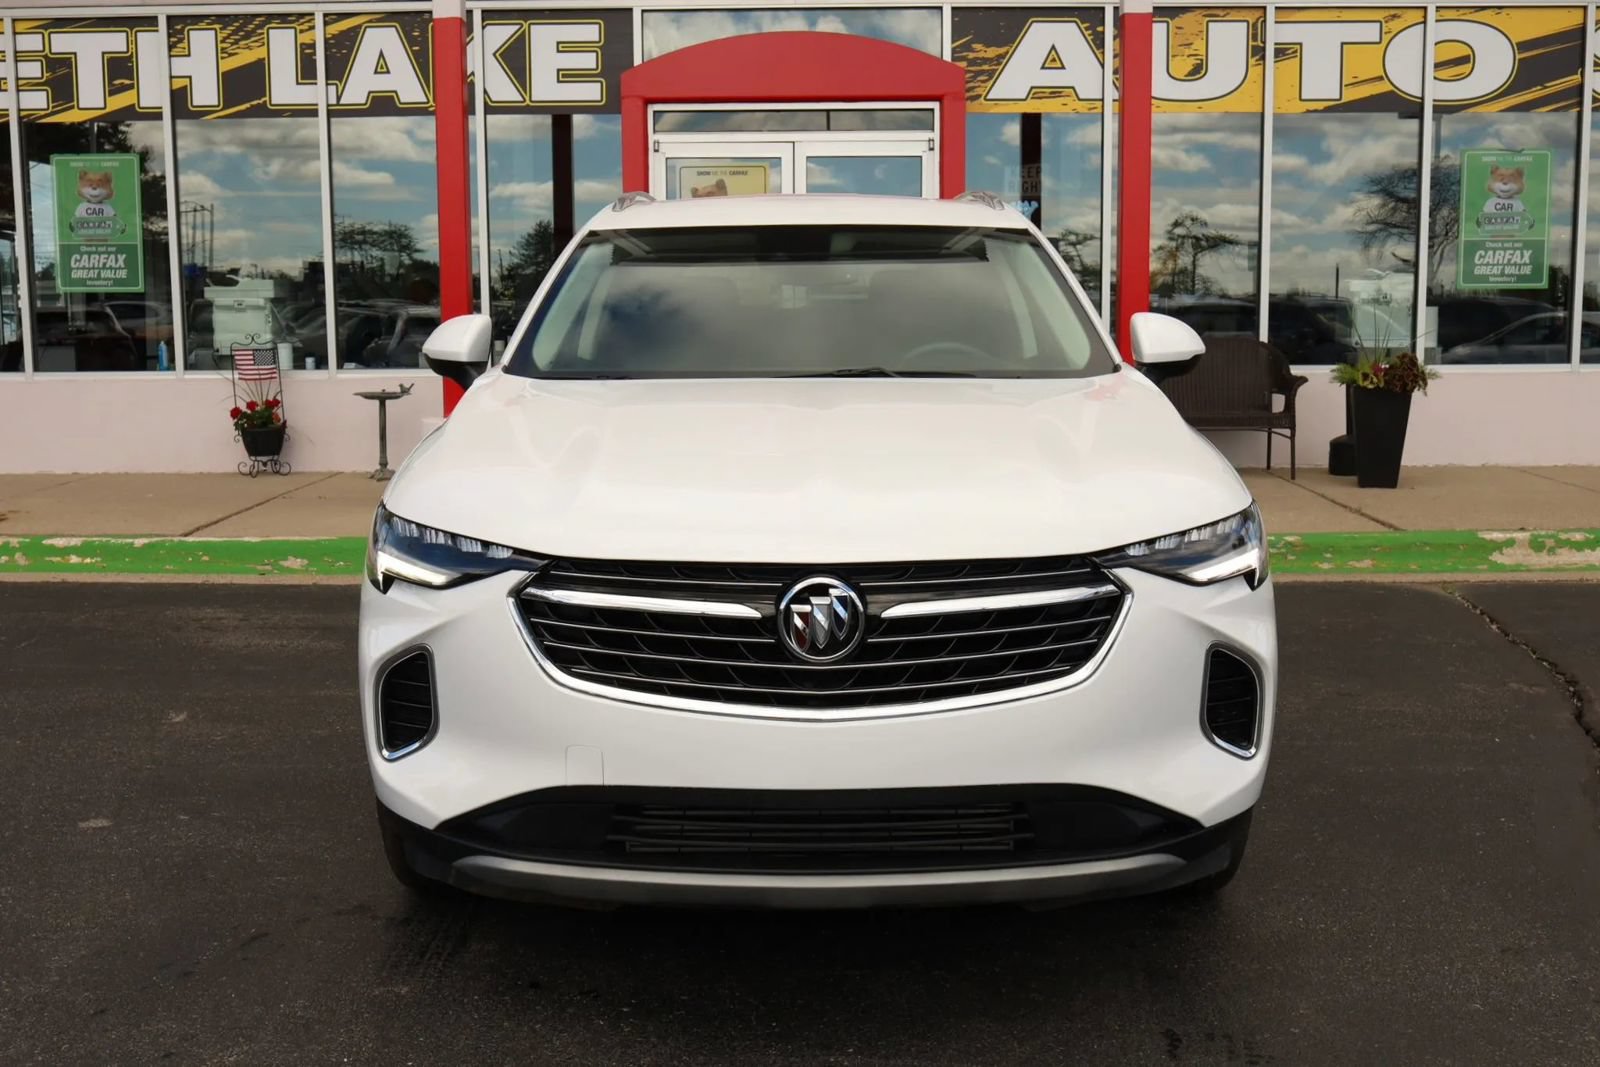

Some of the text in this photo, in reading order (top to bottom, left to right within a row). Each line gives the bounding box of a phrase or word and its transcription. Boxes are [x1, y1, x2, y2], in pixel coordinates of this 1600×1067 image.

[984, 18, 1518, 102] AUTO
[85, 207, 104, 216] CAR
[1494, 202, 1514, 212] CAR
[71, 254, 126, 268] CARFAX
[1474, 250, 1532, 264] CARFAX
[71, 269, 128, 279] GREAT VALUE
[1473, 265, 1533, 275] GREAT VALUE
